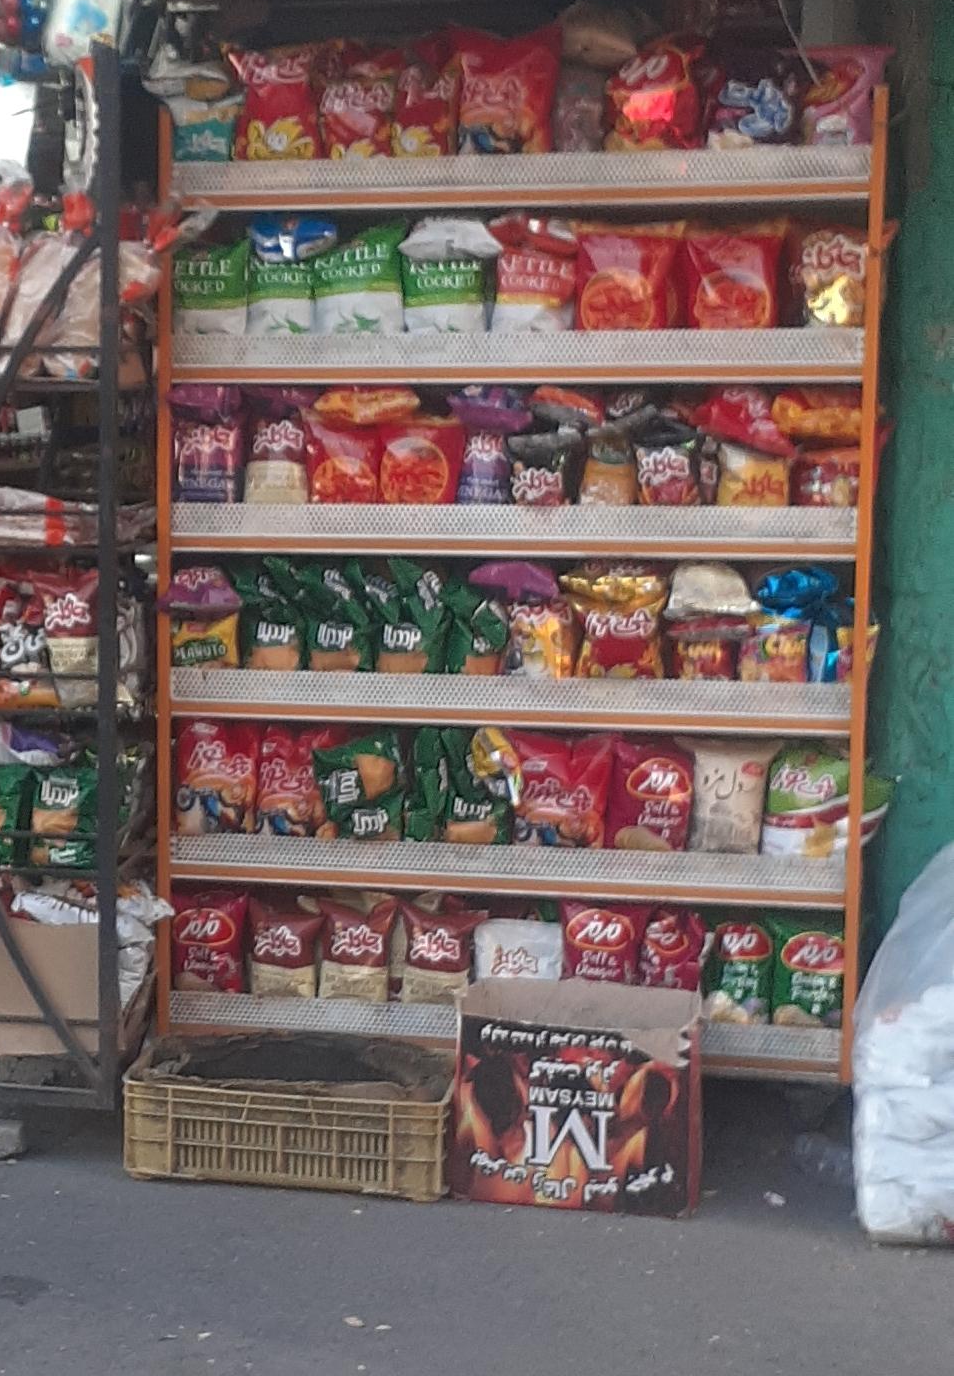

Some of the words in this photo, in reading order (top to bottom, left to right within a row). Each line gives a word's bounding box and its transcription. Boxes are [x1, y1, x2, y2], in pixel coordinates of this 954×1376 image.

[174, 257, 232, 279] ETTLE
[314, 240, 390, 270] KETTLE
[321, 262, 382, 279] COOKED
[638, 447, 691, 486] چاکلز
[180, 912, 221, 941] مزمز
[253, 924, 303, 958] چاکلز
[331, 924, 384, 957] چاکلز
[575, 913, 623, 945] مزمز
[410, 927, 462, 961] چاکلز
[528, 1086, 616, 1109] MEYSAM
[525, 1104, 615, 1172] M
